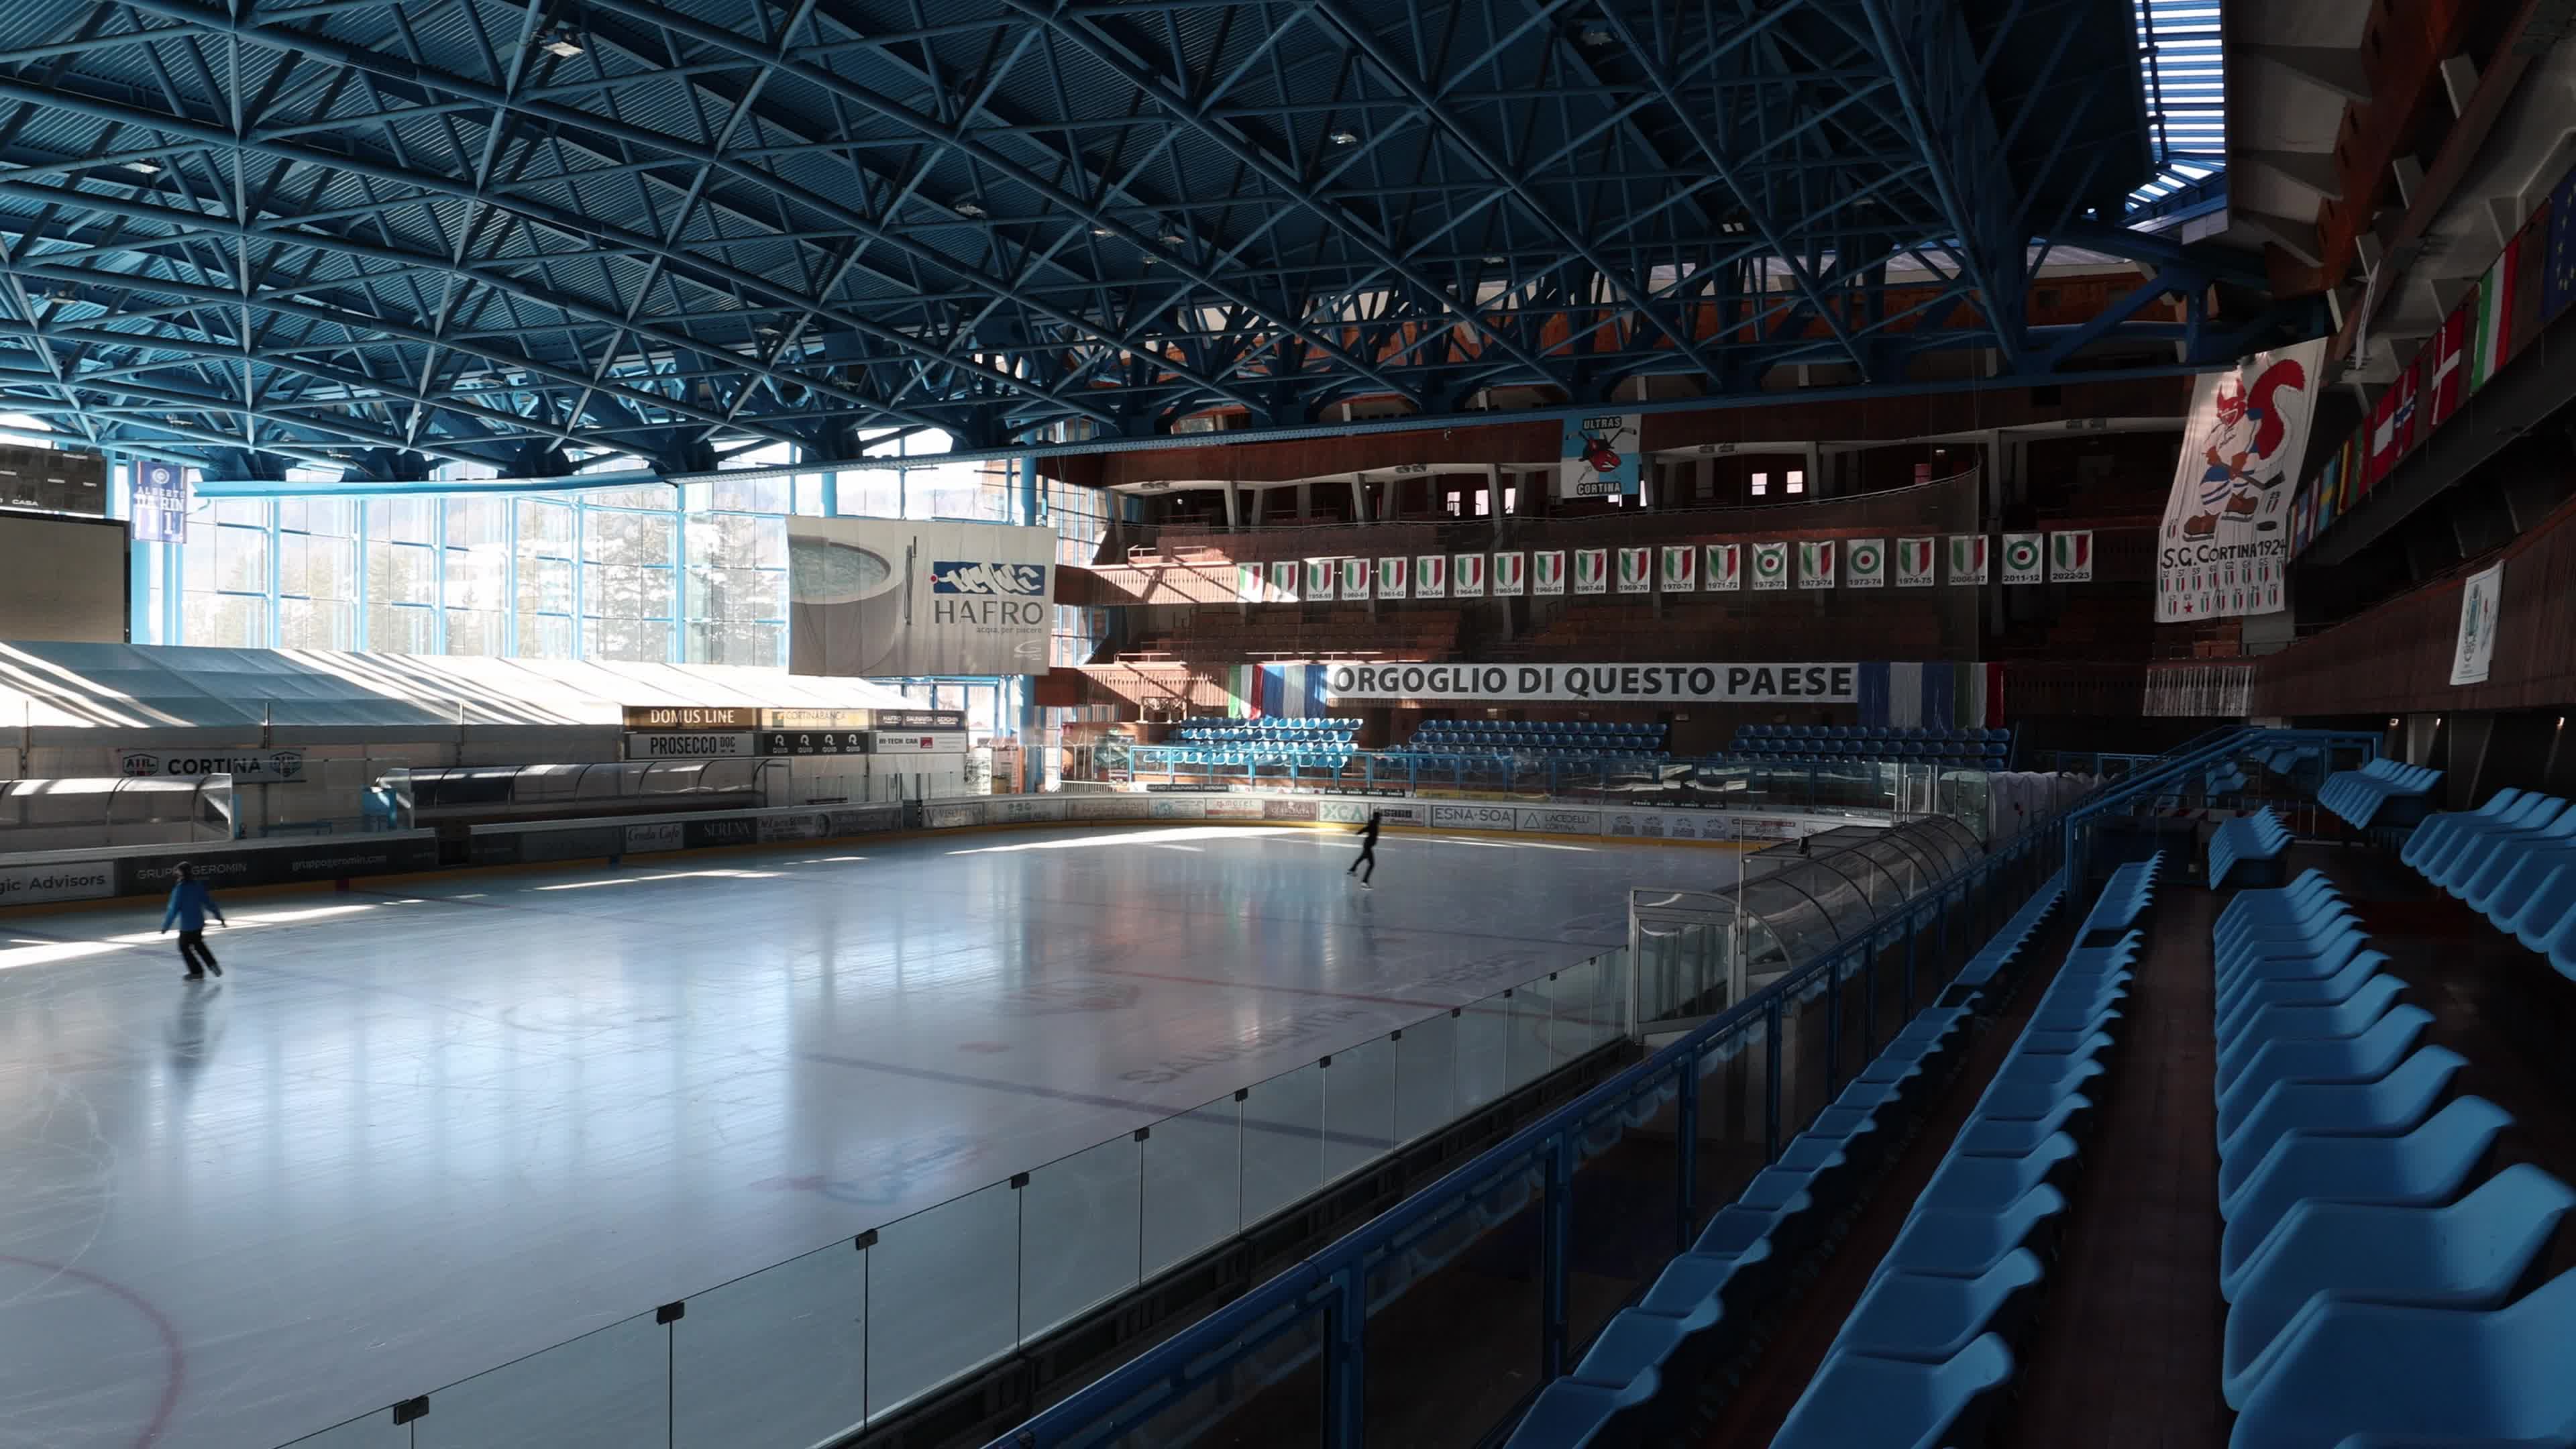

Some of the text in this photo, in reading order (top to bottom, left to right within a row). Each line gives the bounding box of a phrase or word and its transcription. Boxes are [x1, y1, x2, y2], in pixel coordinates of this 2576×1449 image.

[1583, 417, 1621, 429] ULTRAS
[1578, 482, 1621, 494] CORTINA
[1899, 576, 1932, 584] 1974-75
[2004, 574, 2040, 582] 2011-12
[2053, 572, 2090, 580] 2022-23
[934, 600, 1044, 625] HAFRO
[1334, 667, 1852, 698] ORGOGLIO DI QUESTO PAESE
[651, 709, 735, 723] DOMUS LINE
[650, 737, 736, 755] PROSECCO DOC
[168, 758, 261, 774] CORTINA
[1434, 808, 1511, 822] ESNA-SOA
[192, 863, 248, 876] GEROMIN
[30, 874, 105, 890] Advisors
